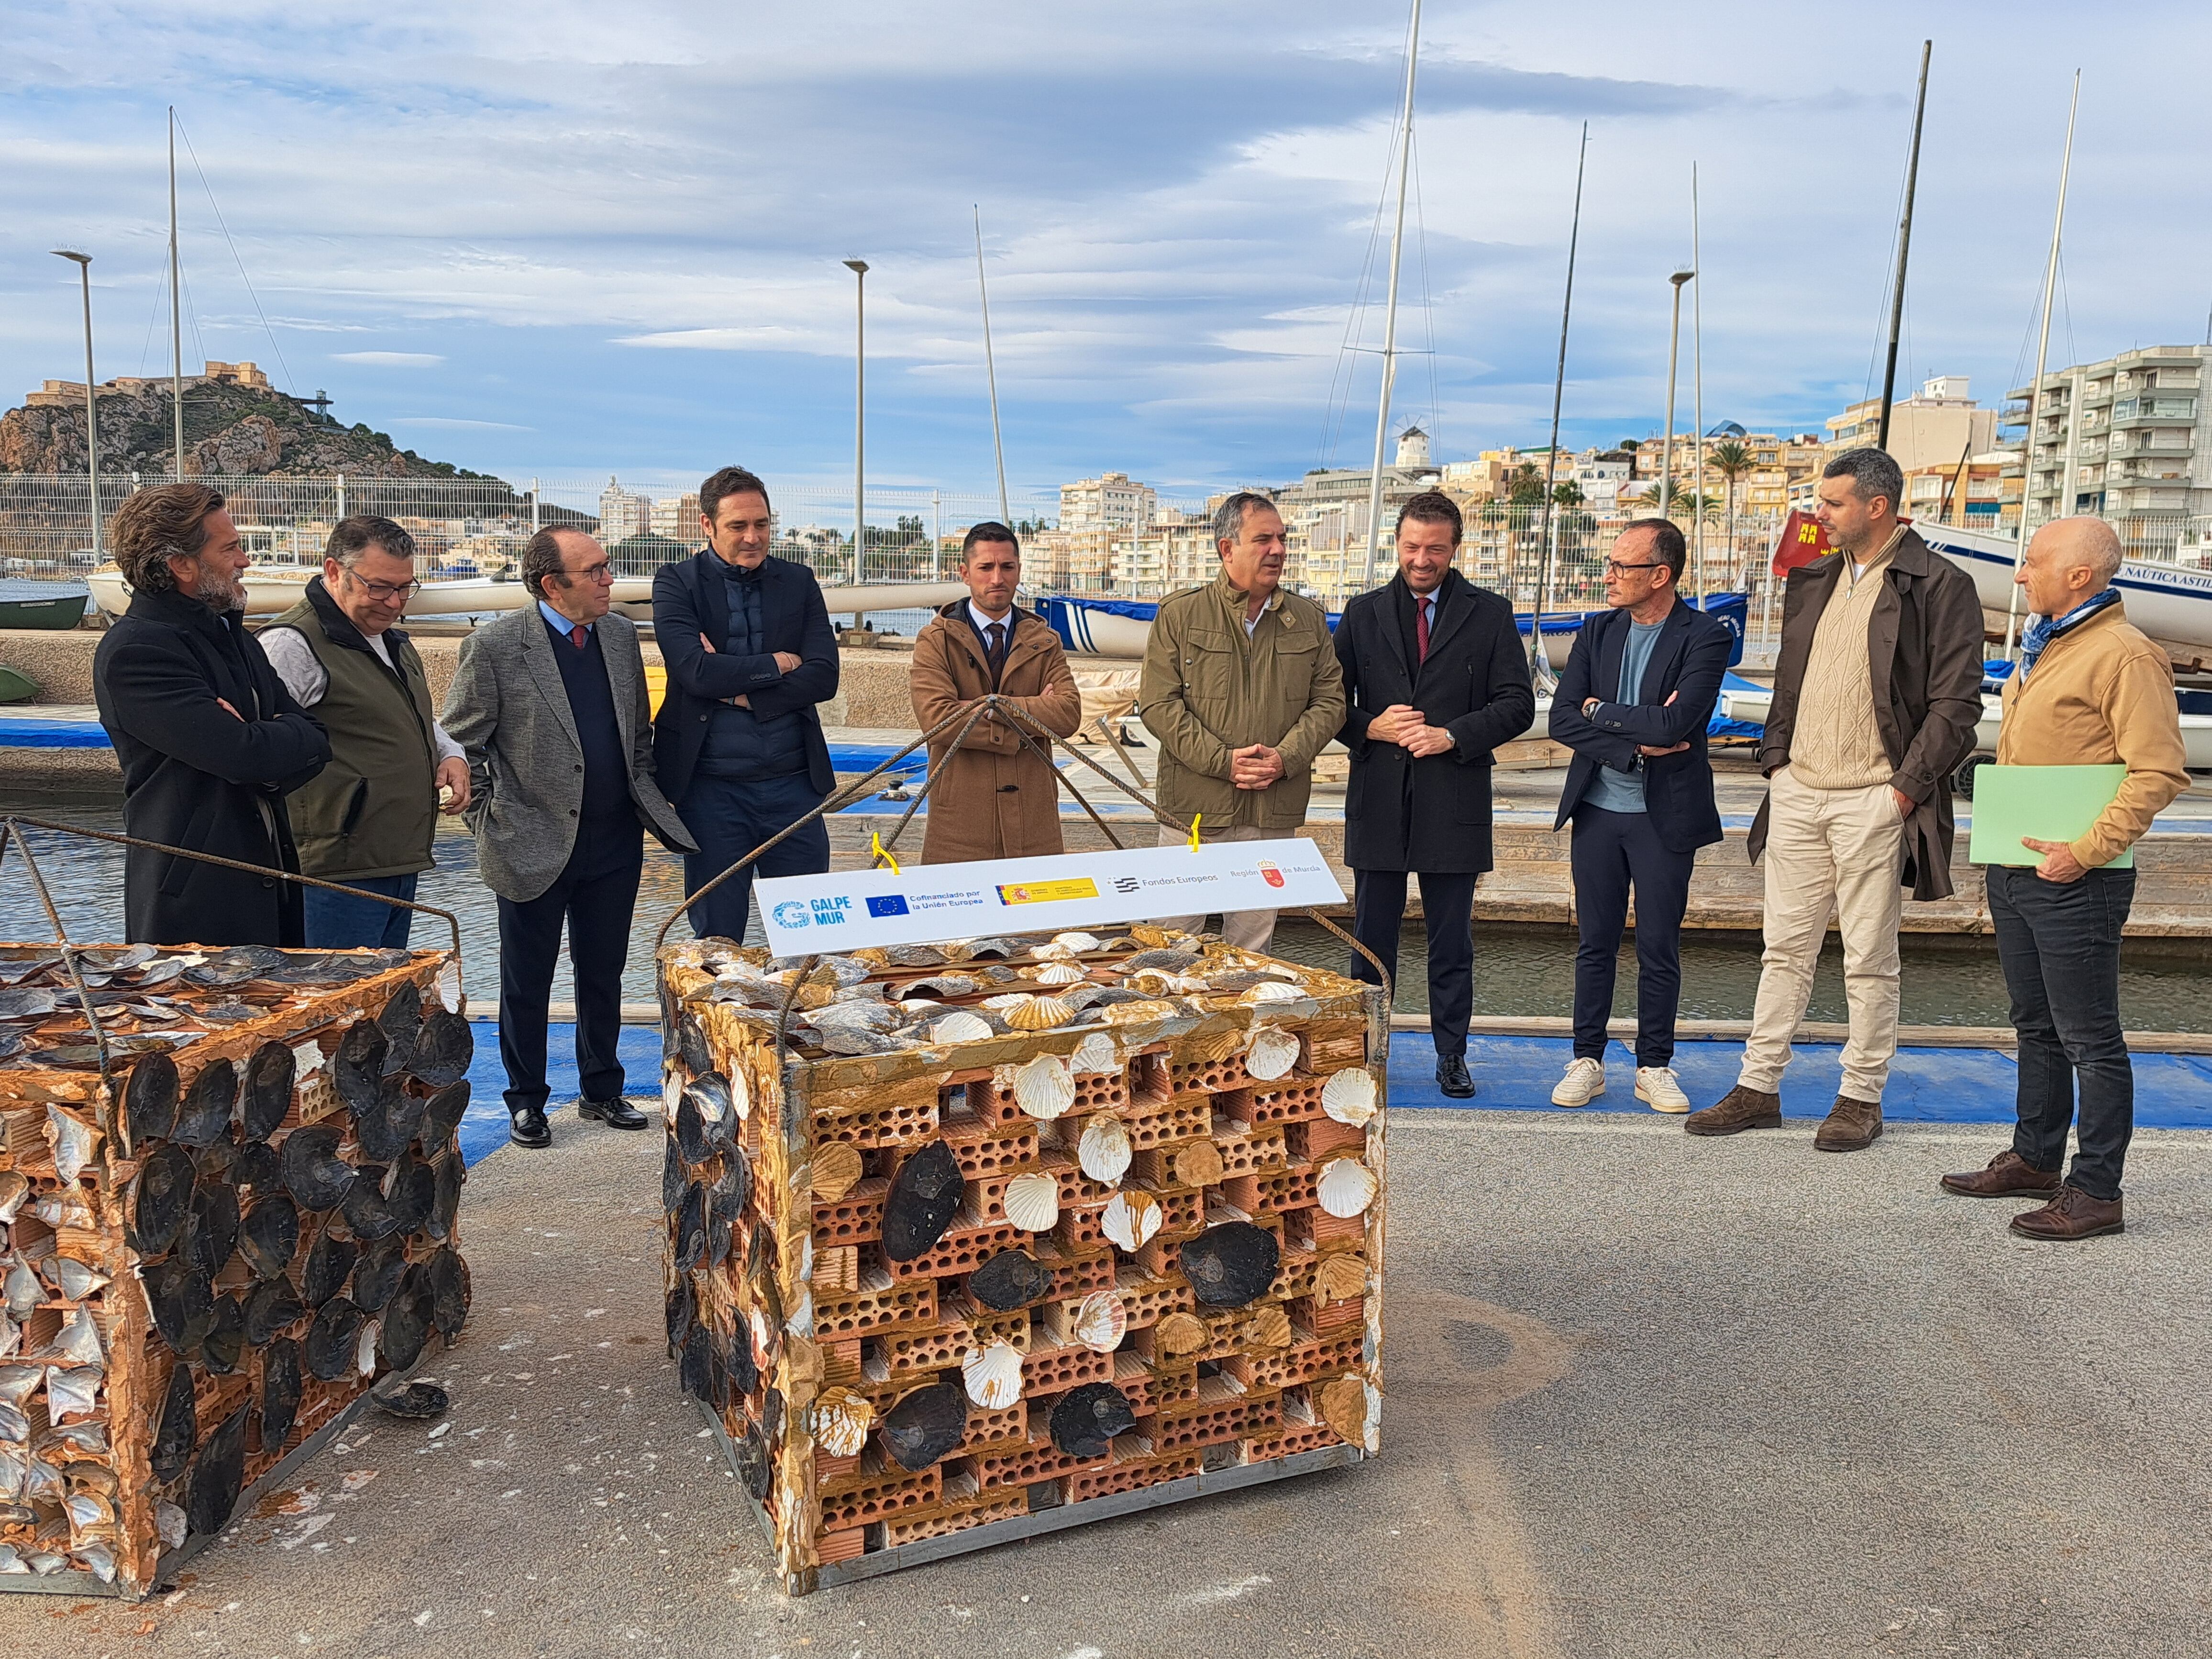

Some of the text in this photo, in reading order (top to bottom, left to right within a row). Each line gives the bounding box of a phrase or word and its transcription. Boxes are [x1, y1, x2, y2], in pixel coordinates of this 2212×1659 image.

[1230, 869, 1259, 877] Región
[1293, 865, 1321, 873] Murcia
[1142, 874, 1218, 886] Fondos Europeos
[910, 891, 964, 902] Cofinanciado
[810, 896, 852, 912] GALPE
[814, 911, 845, 926] MUR
